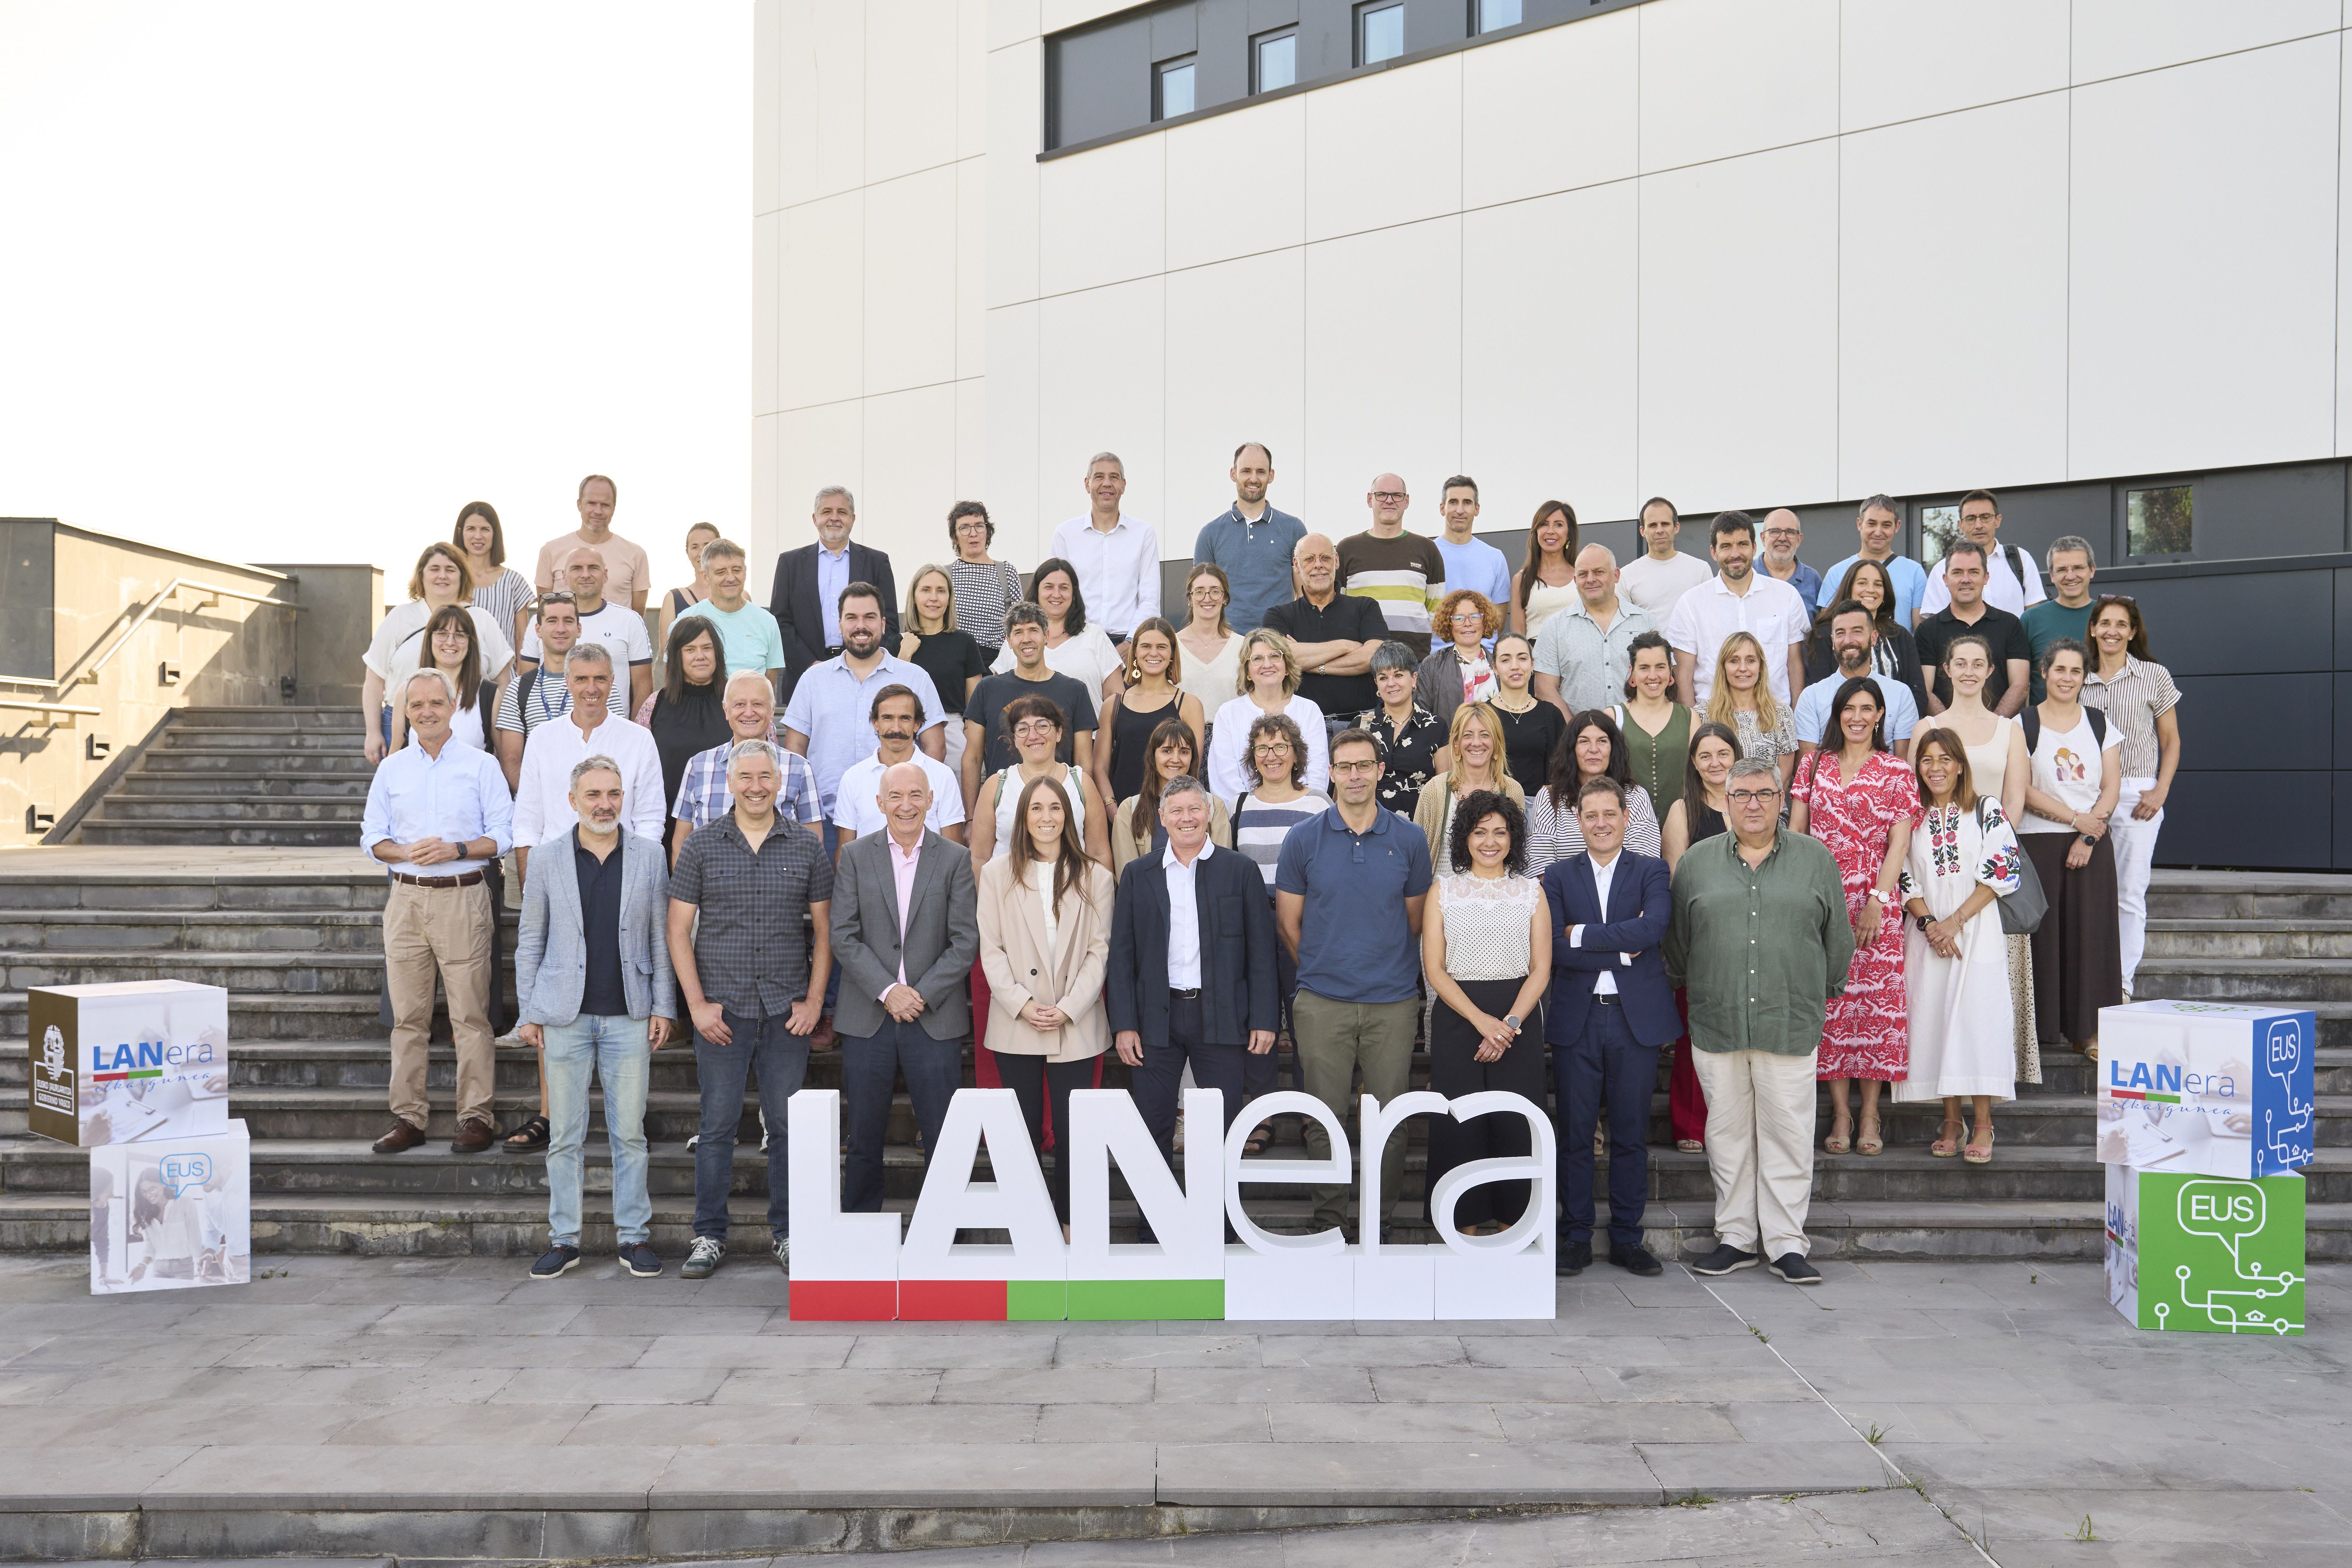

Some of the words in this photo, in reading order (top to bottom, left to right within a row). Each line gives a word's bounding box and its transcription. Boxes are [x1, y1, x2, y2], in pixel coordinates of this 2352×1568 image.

[93, 1041, 212, 1071] LANera
[2272, 1033, 2296, 1062] EUS
[37, 1079, 49, 1089] EUSKO
[49, 1083, 72, 1096] JAURLARITZA
[94, 1072, 213, 1093] elkargunea
[2111, 1060, 2234, 1098] LANera
[38, 1092, 58, 1105] GOBIERNO
[58, 1098, 71, 1109] VASCO
[2111, 1098, 2235, 1118] elkargunea
[167, 1162, 204, 1177] EUS
[788, 1088, 1556, 1280] LANera
[2191, 1195, 2254, 1222] EUS
[2108, 1201, 2135, 1246] LANera
